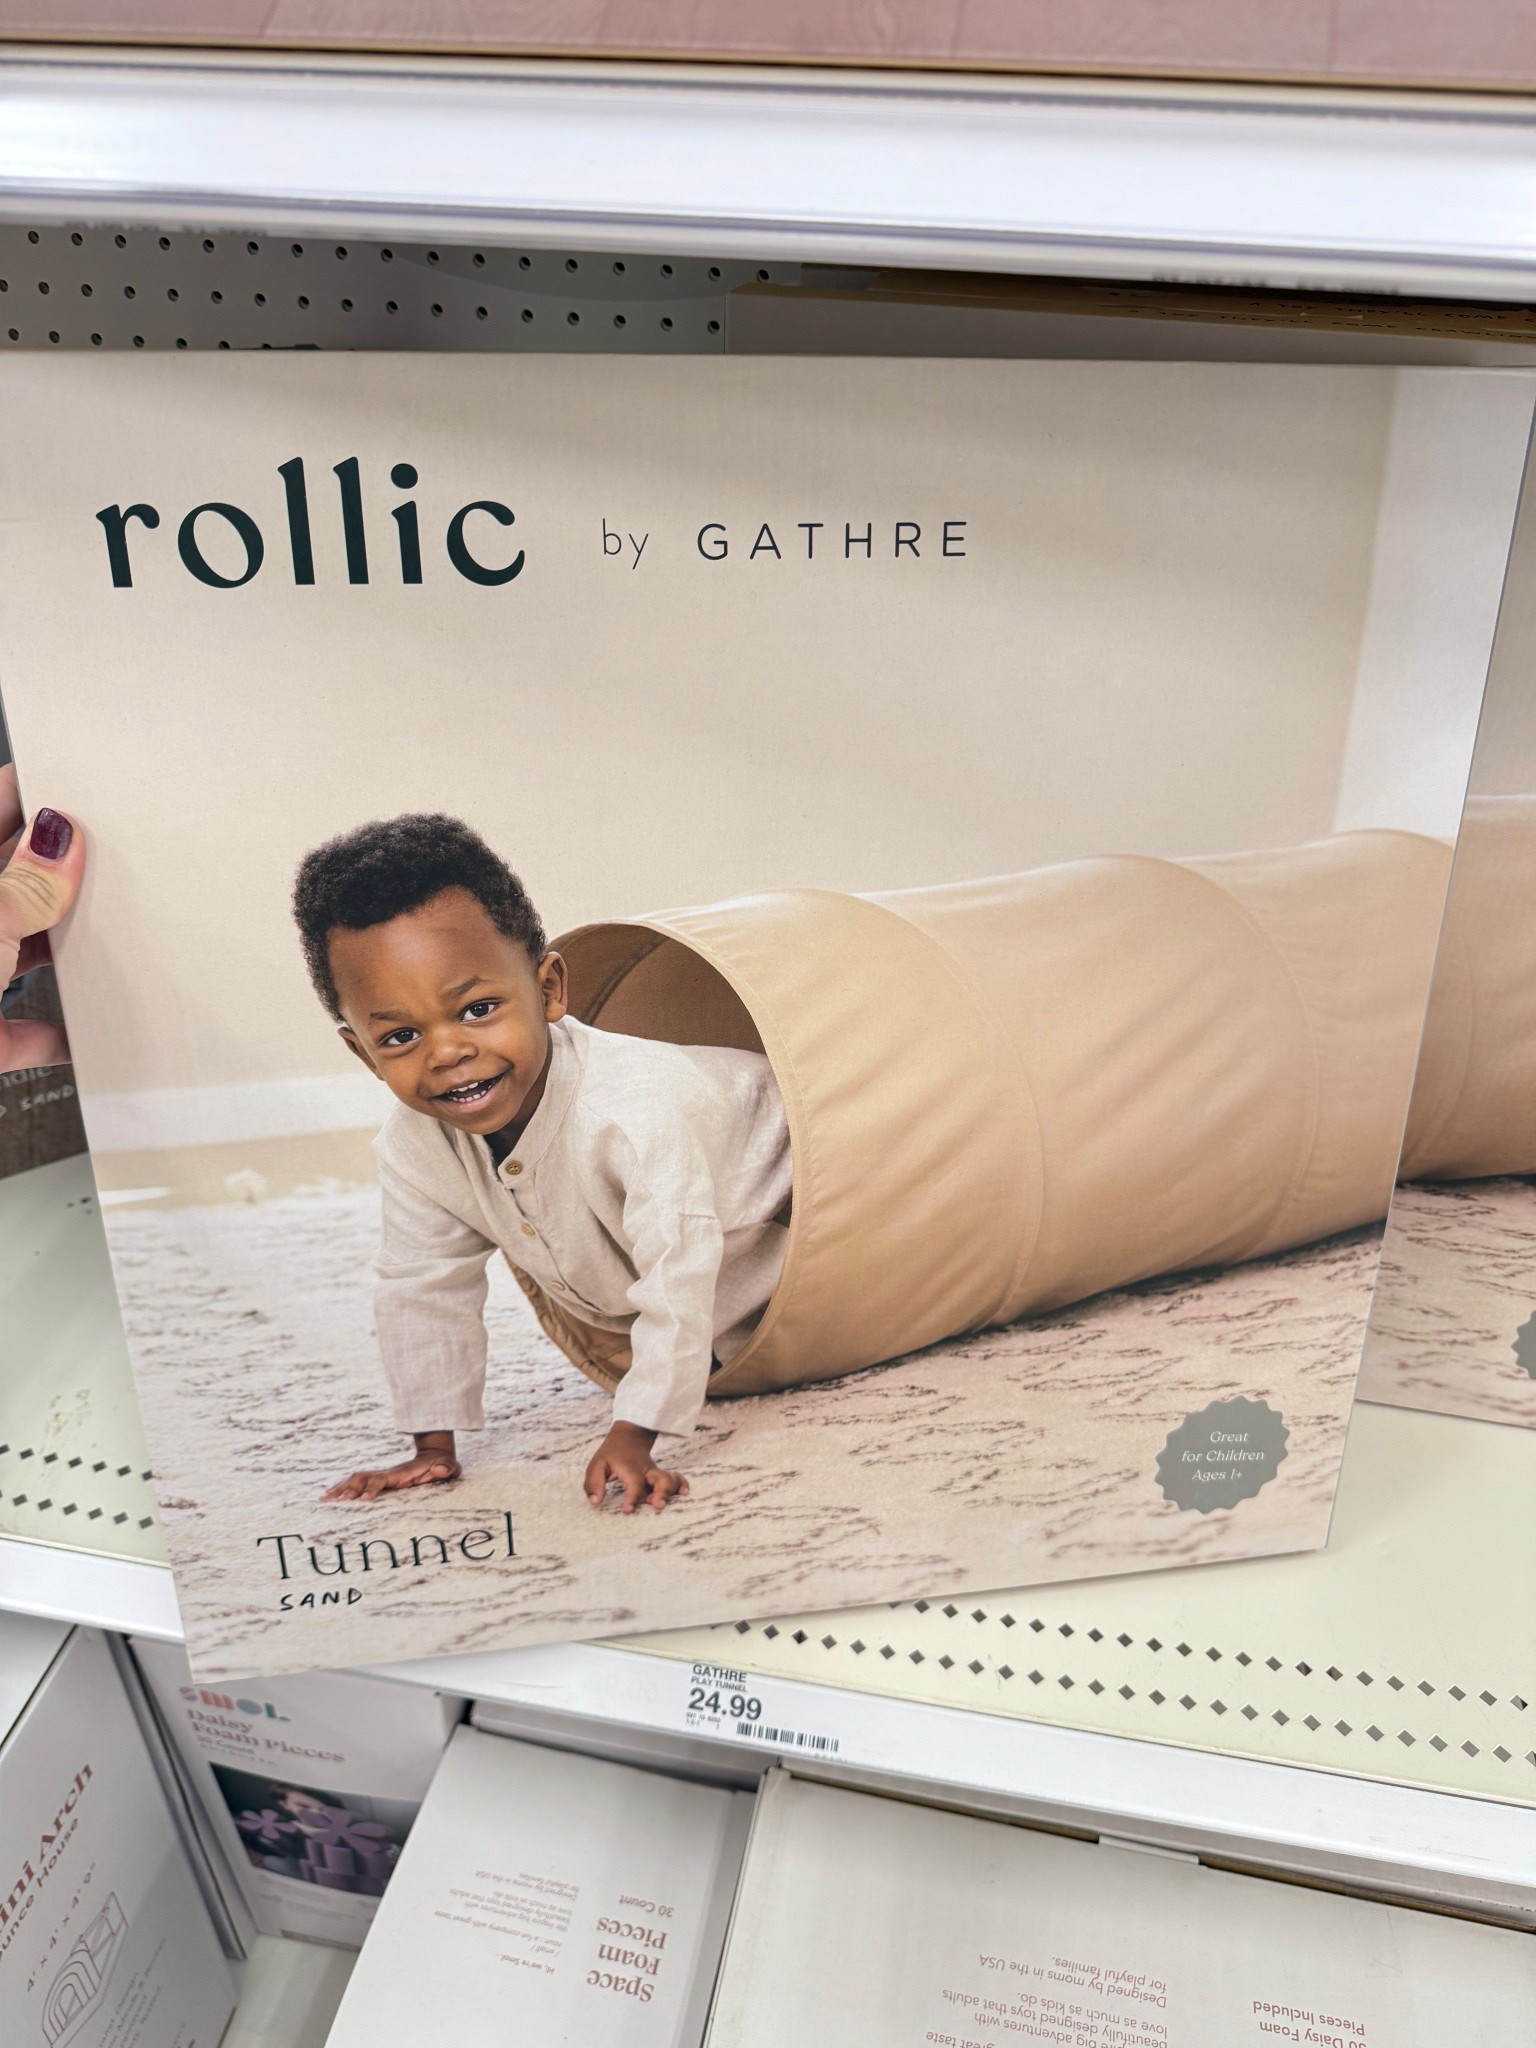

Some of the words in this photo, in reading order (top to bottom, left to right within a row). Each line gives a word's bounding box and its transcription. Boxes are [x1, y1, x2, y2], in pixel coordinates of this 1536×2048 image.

[95, 456, 526, 589] rollic
[602, 518, 649, 570] by
[697, 521, 967, 561] GATHRE
[1210, 1430, 1249, 1443] Great
[1181, 1450, 1202, 1462] for
[1206, 1449, 1265, 1462] Children
[1192, 1469, 1227, 1482] Ages
[256, 1510, 518, 1580] Tunnel
[280, 1587, 363, 1611] SAND
[692, 1663, 748, 1683] GATHRE
[690, 1676, 713, 1686] PLAY
[715, 1679, 748, 1693] TUNNEL
[688, 1687, 762, 1721] 24.99
[187, 1708, 253, 1733] Daisy
[264, 1738, 345, 1762] Pieces
[40, 1764, 93, 1864] Arch
[0, 1894, 34, 1961] unce
[37, 1818, 79, 1888] House
[619, 1895, 655, 1913] Count
[658, 1905, 674, 1917] 30
[596, 1917, 668, 1949] Pieces
[597, 1944, 661, 1976] Foam
[979, 1954, 1005, 1971] USA
[1009, 1960, 1030, 1976] the
[1051, 1956, 1101, 1979] families.
[1033, 1966, 1044, 1981] in
[1047, 1970, 1085, 1987] moms
[1104, 1970, 1146, 1988] playful
[587, 1970, 654, 2002] Space
[1088, 1977, 1104, 1995] by
[1148, 1980, 1167, 1994] for
[942, 1989, 979, 2006] adults
[1017, 1991, 1037, 2006] do.
[1106, 1984, 1167, 2008] Designed
[983, 1999, 1007, 2016] that
[1010, 2004, 1036, 2019] toys
[1040, 1999, 1065, 2016] kids
[1068, 2004, 1082, 2015] as
[1086, 2008, 1120, 2024] much
[1253, 2001, 1315, 2026] Included
[975, 2012, 1000, 2027] with
[1040, 2012, 1098, 2037] designed
[1123, 2017, 1137, 2028] as
[1319, 2014, 1365, 2036] Pieces
[925, 2031, 957, 2047] taste
[1003, 2018, 1072, 2043] adventures
[1141, 2022, 1167, 2040] love
[1259, 2021, 1300, 2041] Foam
[1304, 2028, 1343, 2048] Daisy
